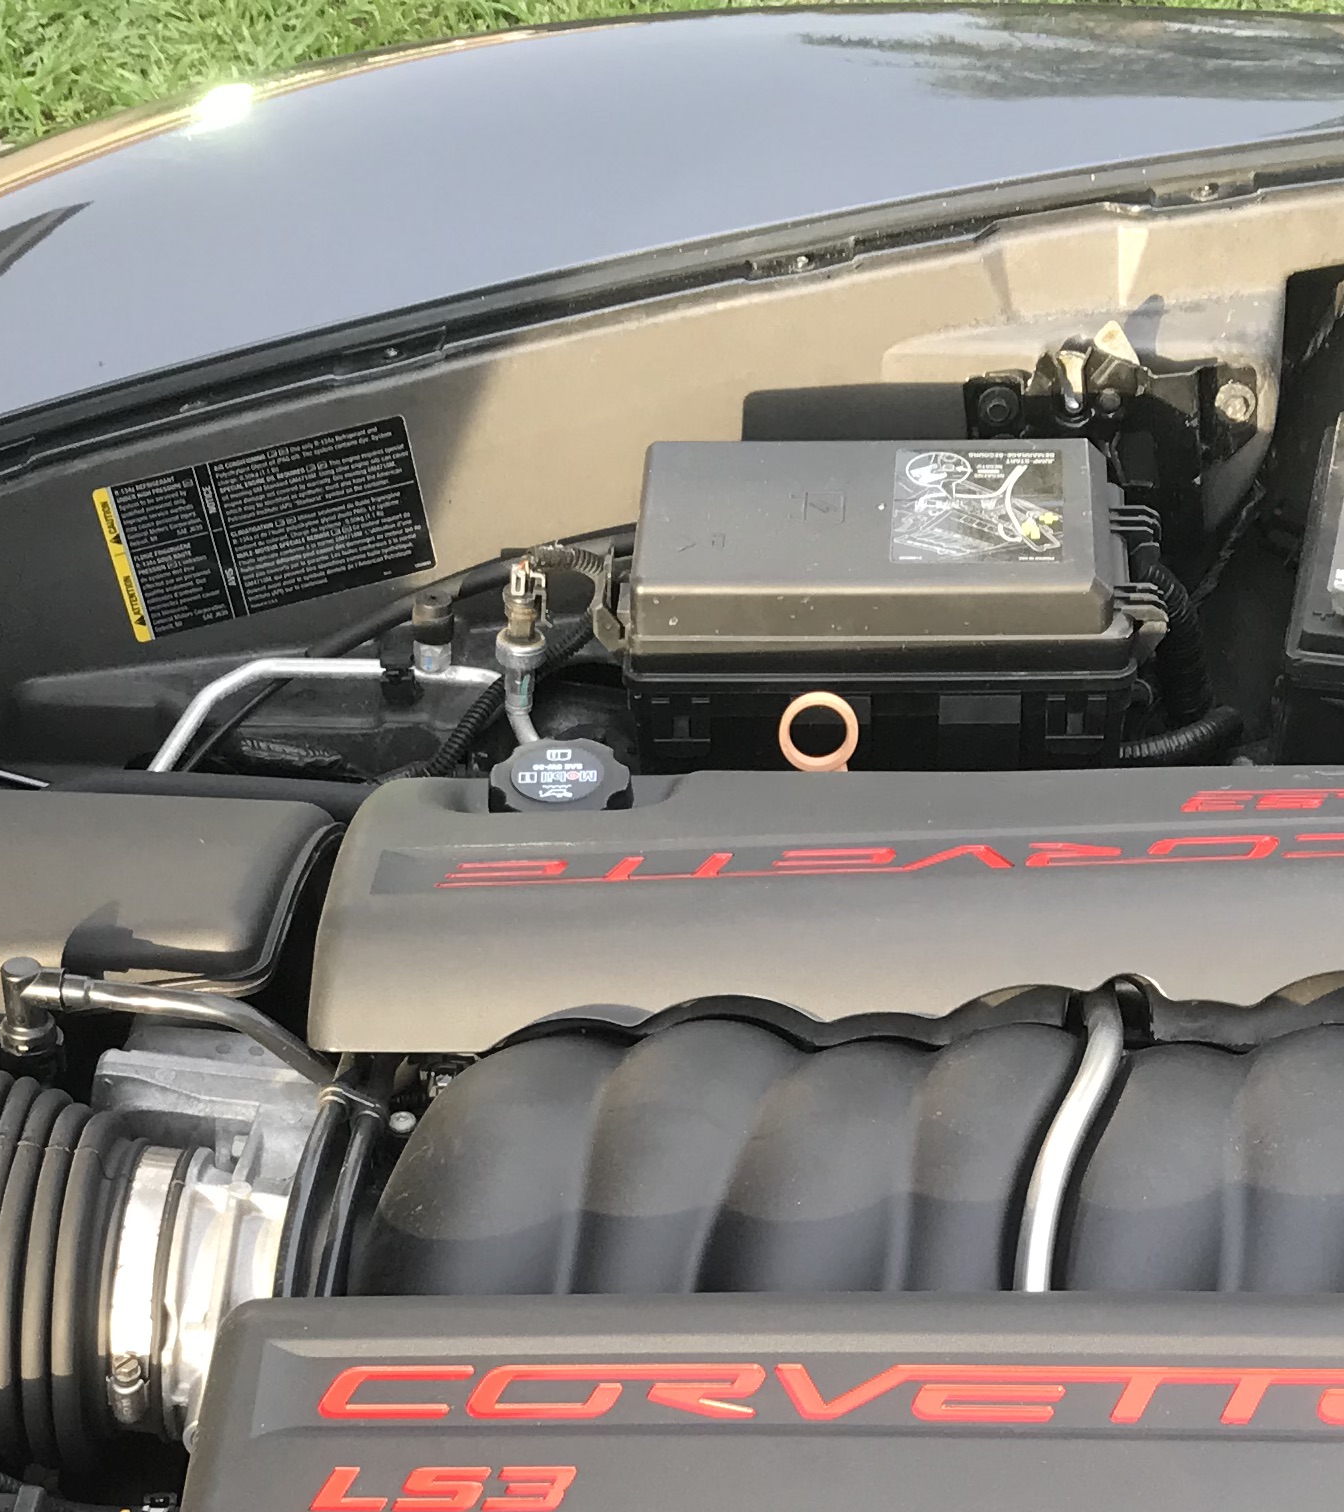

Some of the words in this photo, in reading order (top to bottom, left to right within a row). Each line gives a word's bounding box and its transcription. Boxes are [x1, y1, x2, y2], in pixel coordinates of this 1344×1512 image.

[99, 501, 118, 535] CAUTION
[123, 574, 141, 617] ATTENTION
[541, 770, 597, 783] Mobil
[308, 1467, 577, 1512] LS3
